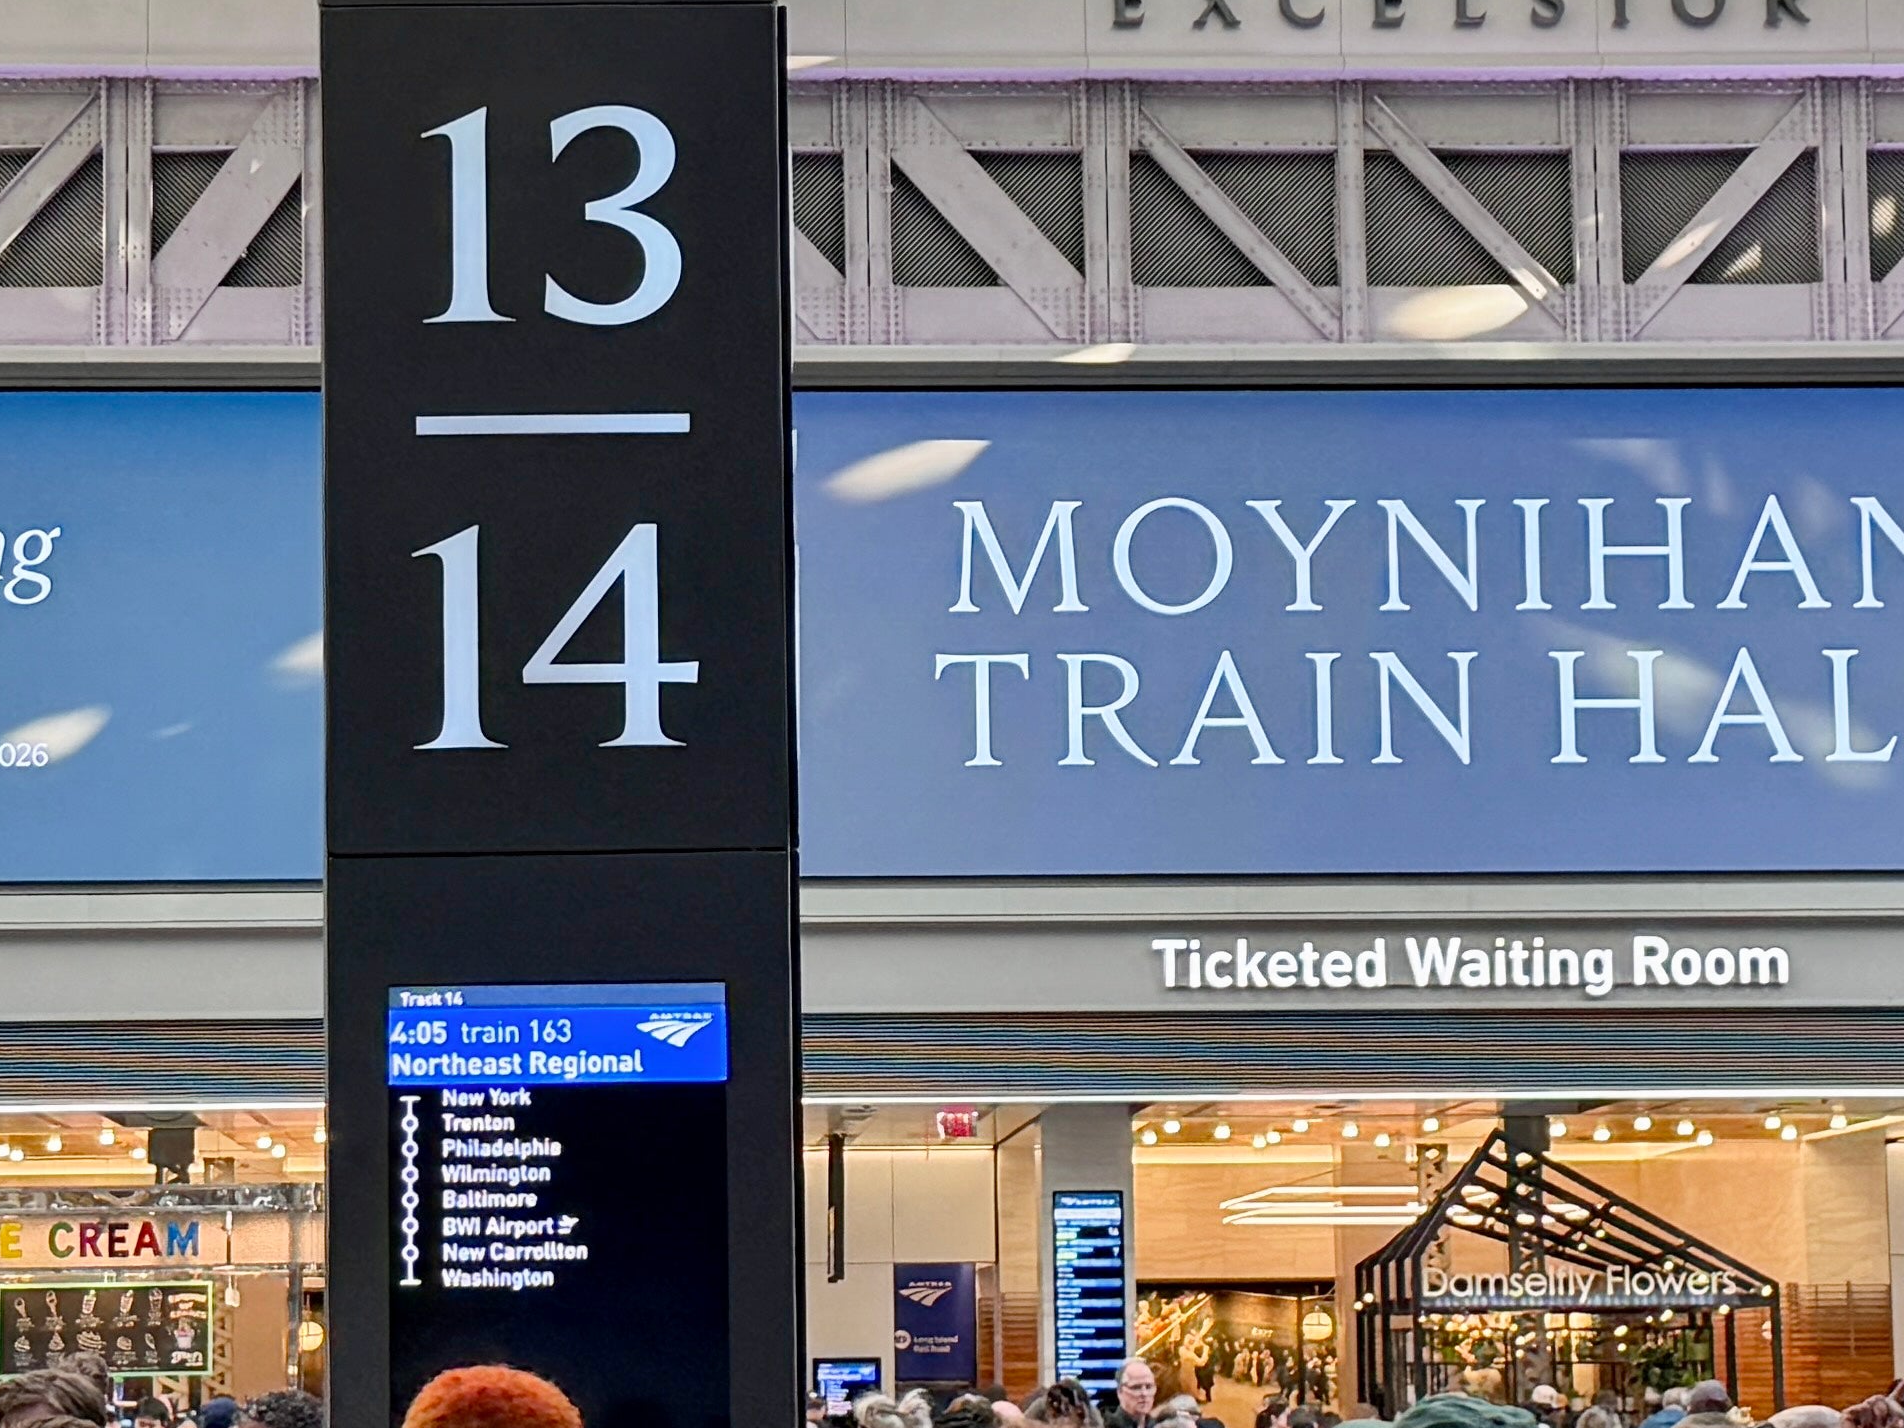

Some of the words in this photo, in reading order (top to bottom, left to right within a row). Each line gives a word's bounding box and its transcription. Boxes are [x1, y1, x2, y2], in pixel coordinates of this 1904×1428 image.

[420, 104, 683, 326] 13
[411, 523, 700, 750] 14
[934, 650, 1479, 768] TRAIN
[1151, 938, 1388, 988] Ticketed
[1404, 936, 1615, 996] Waiting
[1632, 935, 1791, 985] Room
[399, 991, 443, 1007] Track
[444, 990, 464, 1006] 14
[390, 1019, 448, 1045] 4:05
[460, 1020, 520, 1044] train
[530, 1018, 572, 1043] 163
[391, 1052, 522, 1077] Northeast
[529, 1049, 644, 1080] Regional
[442, 1088, 485, 1107] New
[489, 1086, 533, 1106] York
[441, 1112, 516, 1132] Trenton
[441, 1137, 563, 1160] Philadelphia
[441, 1163, 552, 1187] Wilmington
[442, 1189, 538, 1209] Baltimore
[442, 1216, 481, 1237] BWI
[485, 1215, 555, 1239] Airport
[48, 1220, 200, 1259] CREAM
[442, 1242, 486, 1262] New
[489, 1241, 589, 1261] Carrollton
[441, 1267, 555, 1291] Washington
[1422, 1266, 1596, 1304] Damselfly
[1606, 1264, 1737, 1298] Flowers
